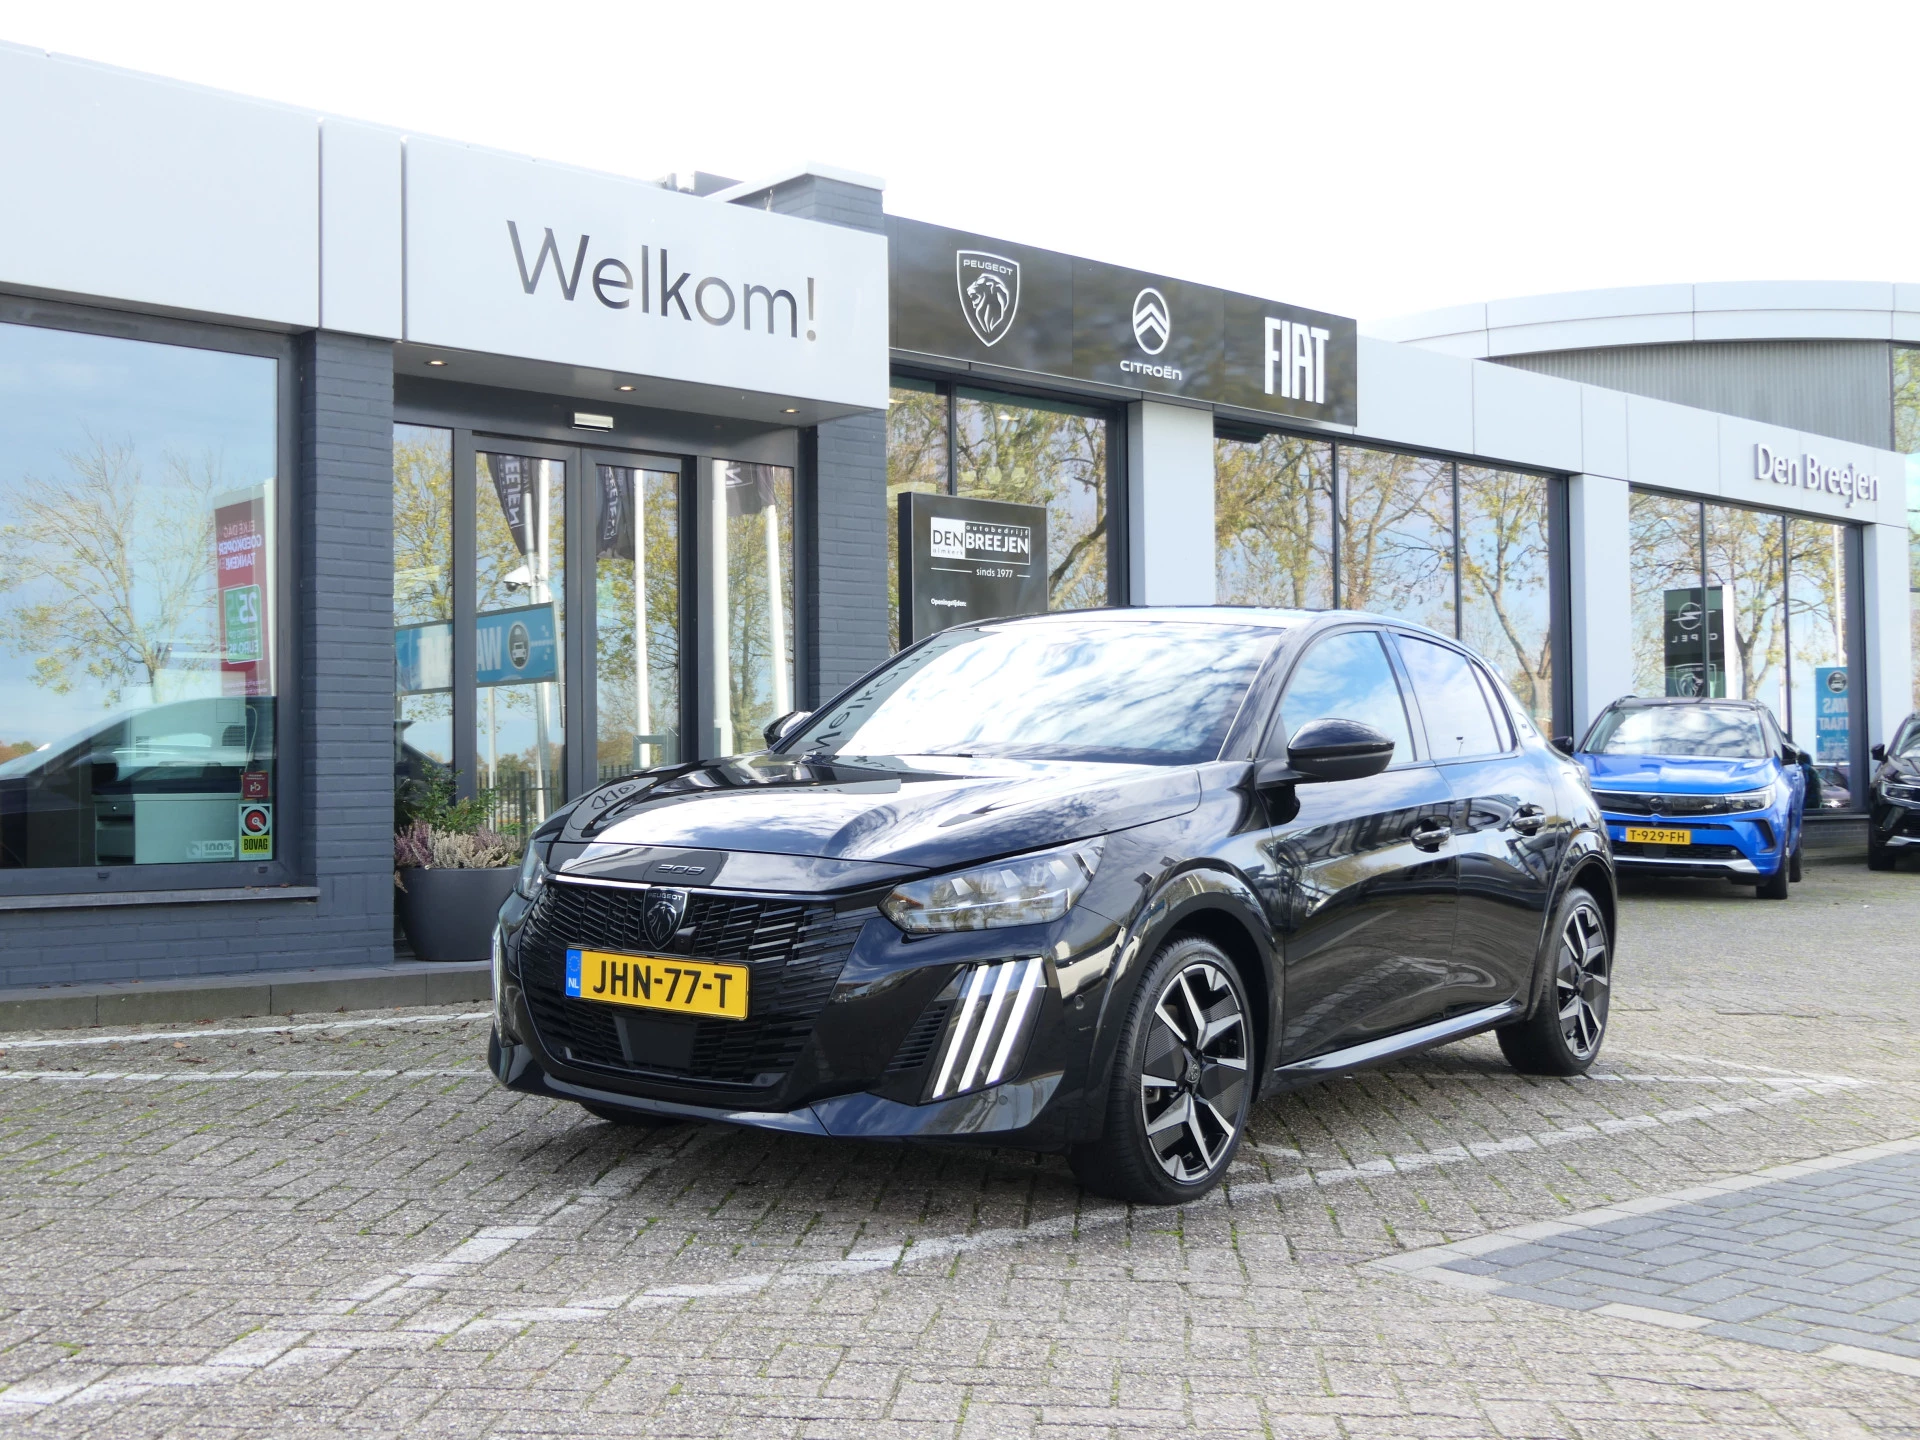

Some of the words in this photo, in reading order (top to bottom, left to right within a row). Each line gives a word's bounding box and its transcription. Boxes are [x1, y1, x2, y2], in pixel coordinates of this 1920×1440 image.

[962, 258, 1014, 276] PEUGEOT
[506, 219, 818, 343] Welkom!
[1264, 316, 1331, 404] FIAT
[1753, 443, 1799, 487] Den
[1802, 453, 1880, 508] Breejen
[933, 529, 964, 548] DEN
[965, 532, 1029, 555] BREEJEN
[976, 567, 995, 577] sinds
[996, 569, 1014, 578] 1977
[243, 838, 268, 851] BOVAG
[1629, 829, 1686, 843] T-929-FH
[647, 892, 684, 902] PEUGEOT
[567, 977, 580, 989] NL
[592, 960, 733, 1009] JHN-77-T
